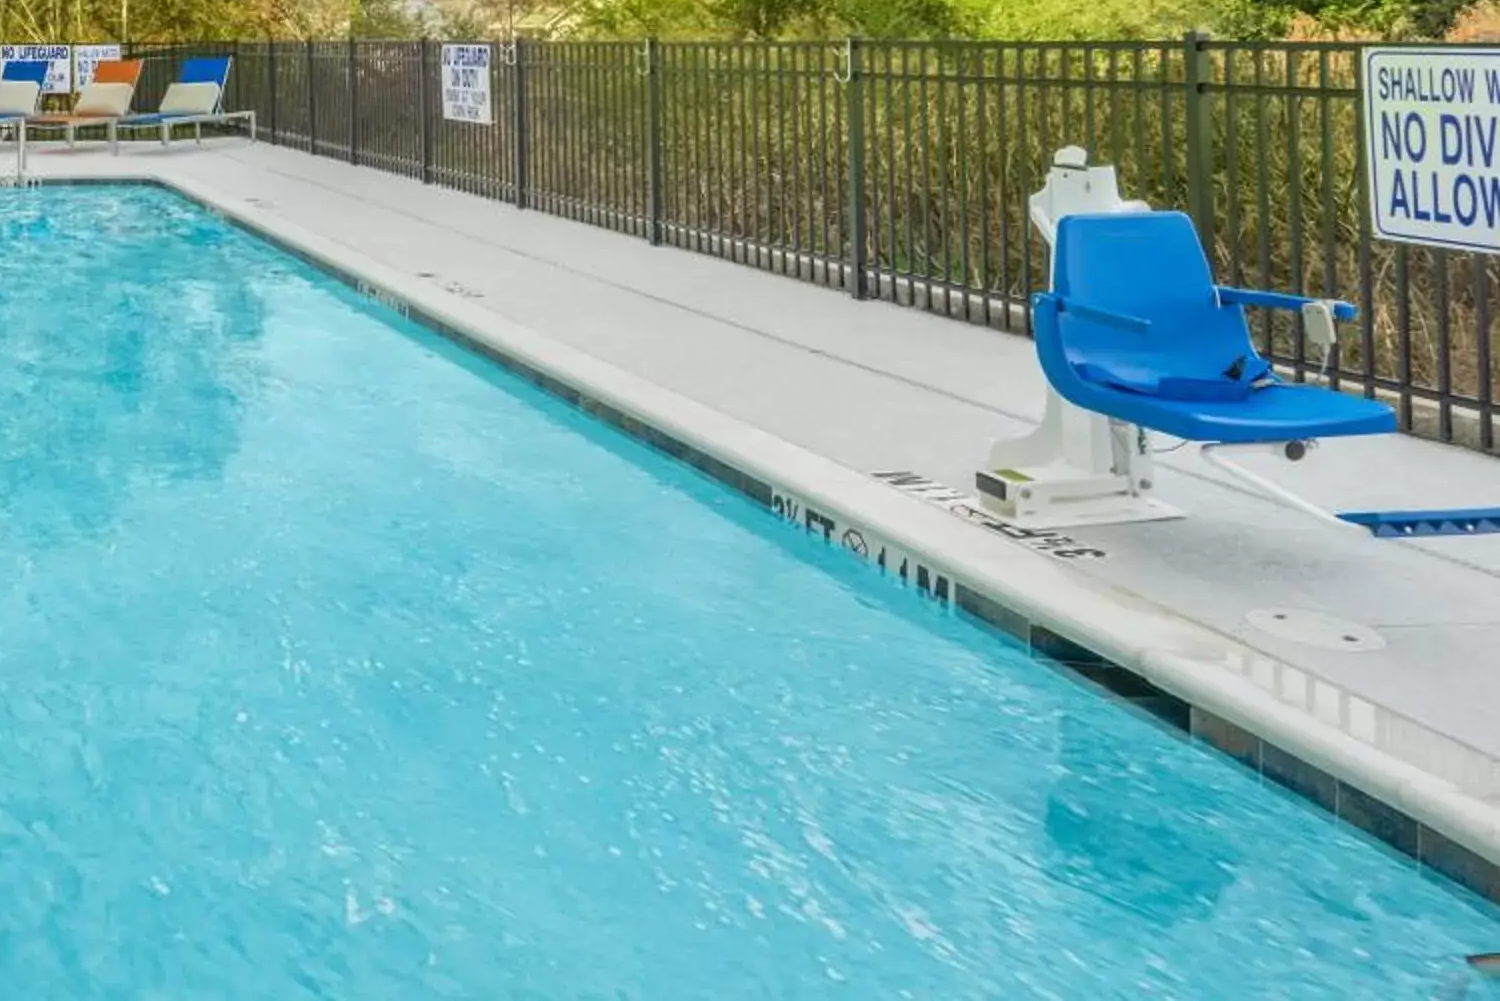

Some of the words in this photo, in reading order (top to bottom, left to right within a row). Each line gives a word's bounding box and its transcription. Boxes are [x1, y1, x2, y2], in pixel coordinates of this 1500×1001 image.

[2, 47, 14, 59] NO
[19, 47, 69, 59] LIFEGUARD
[1378, 66, 1475, 103] SHALLOW
[1381, 110, 1427, 163] NO
[1439, 113, 1498, 168] DIV
[1390, 168, 1500, 229] ALLOW
